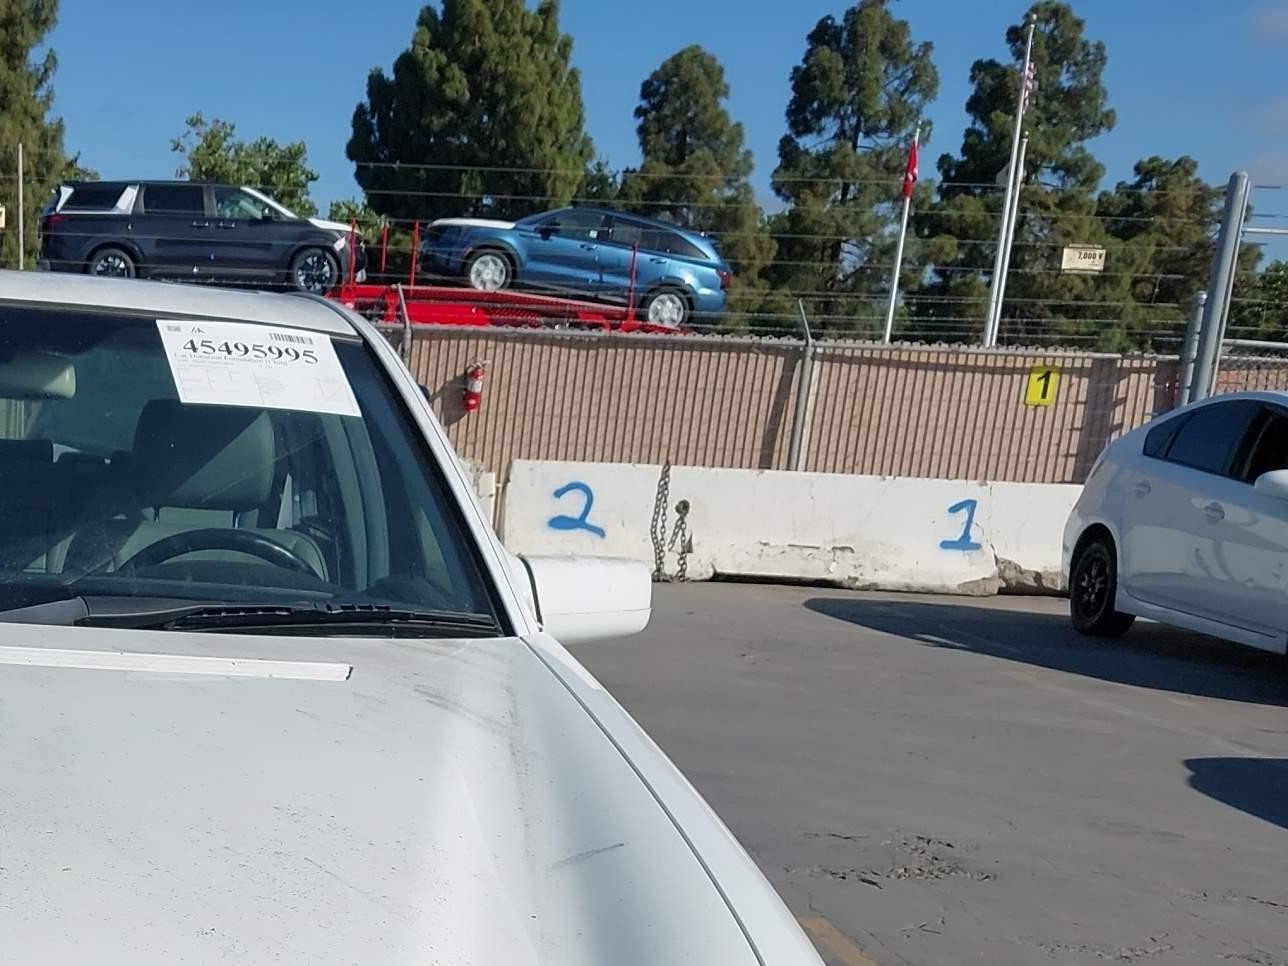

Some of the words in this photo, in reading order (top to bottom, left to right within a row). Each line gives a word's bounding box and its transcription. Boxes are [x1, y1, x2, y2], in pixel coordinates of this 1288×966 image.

[183, 339, 318, 364] 45495995
[1037, 370, 1052, 400] 1
[547, 482, 606, 538] 2
[939, 499, 982, 550] 1
